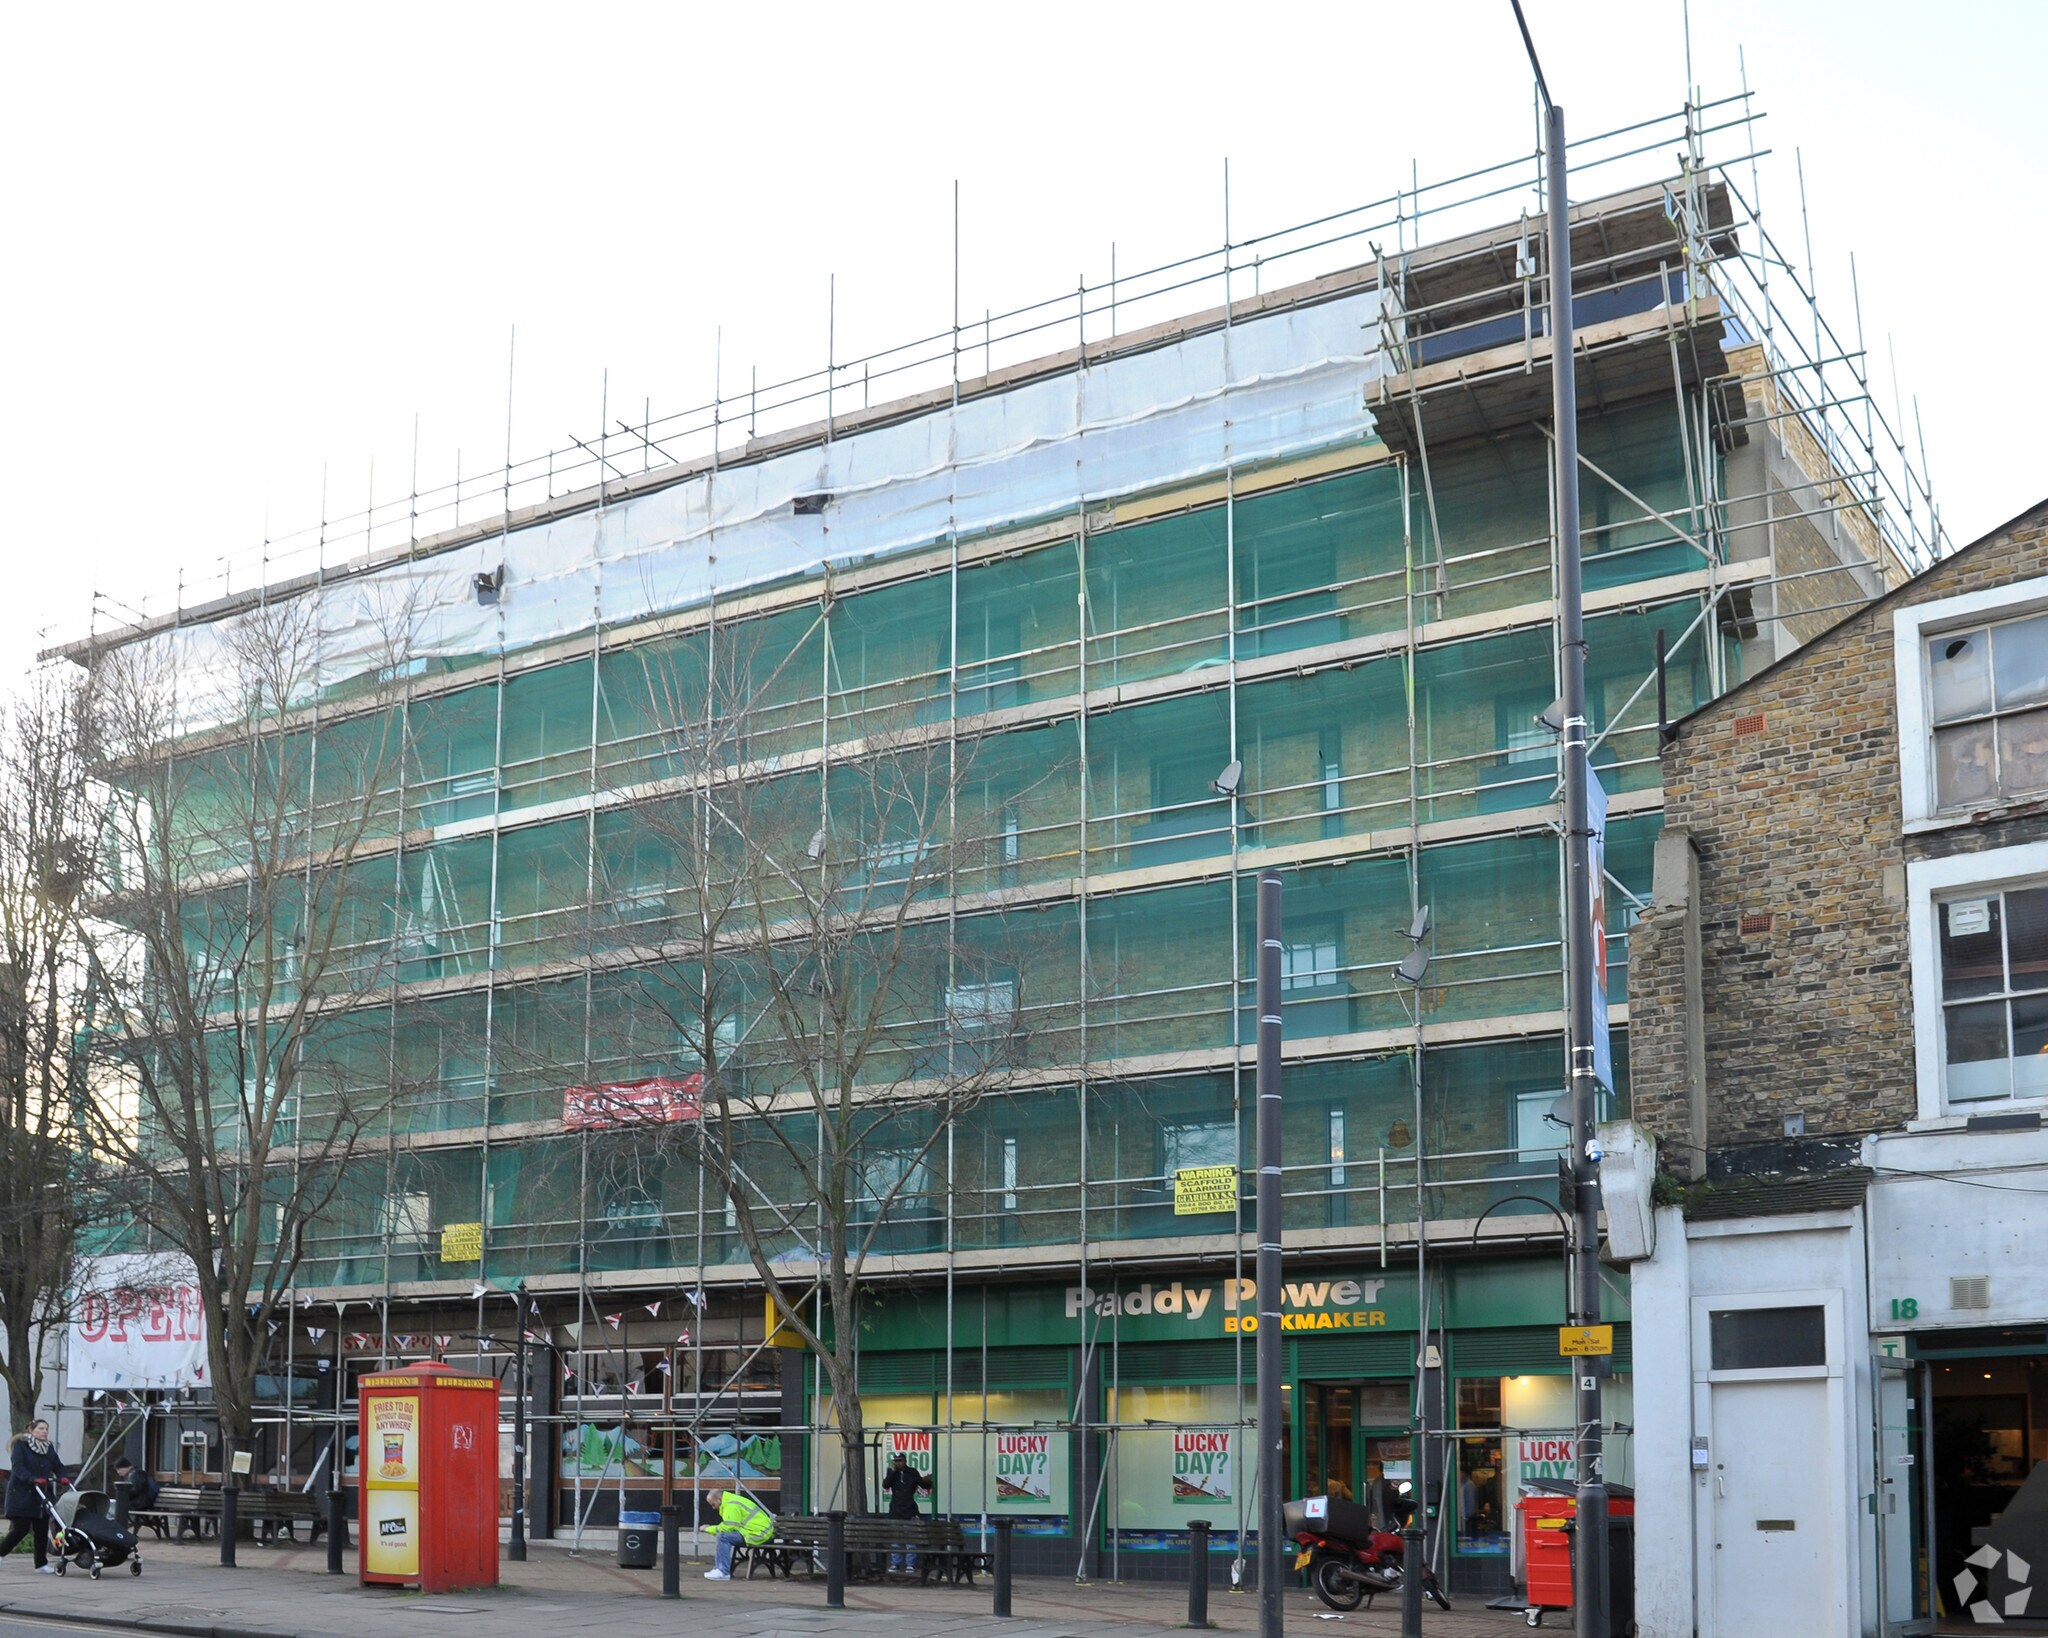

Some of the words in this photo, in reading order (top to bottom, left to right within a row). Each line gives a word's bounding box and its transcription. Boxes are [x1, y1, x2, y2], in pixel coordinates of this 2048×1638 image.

[1180, 1167, 1233, 1180] WARNING
[1180, 1178, 1232, 1187] SCAFFOLD
[1182, 1184, 1231, 1193] ALARMED
[1065, 1281, 1211, 1320] Paddy
[1224, 1278, 1385, 1312] Pwer
[78, 1284, 205, 1343] OPEN
[1891, 1298, 1919, 1320] 18
[1224, 1310, 1386, 1333] BOKMAKER
[369, 1377, 416, 1386] TELEPHONE
[441, 1377, 490, 1388] TELEPHONE
[1583, 1379, 1593, 1389] 4
[373, 1401, 394, 1414] FRIES
[395, 1401, 403, 1412] TO
[404, 1402, 414, 1414] GO
[376, 1420, 412, 1431] ANYWHERE
[893, 1431, 929, 1451] WIN
[997, 1436, 1048, 1454] LUCKY
[1174, 1433, 1229, 1452] LUCKY
[1519, 1440, 1576, 1461] LUCK
[998, 1453, 1048, 1475] DAY?
[1175, 1452, 1229, 1475] DAY?
[1312, 1503, 1320, 1512] L
